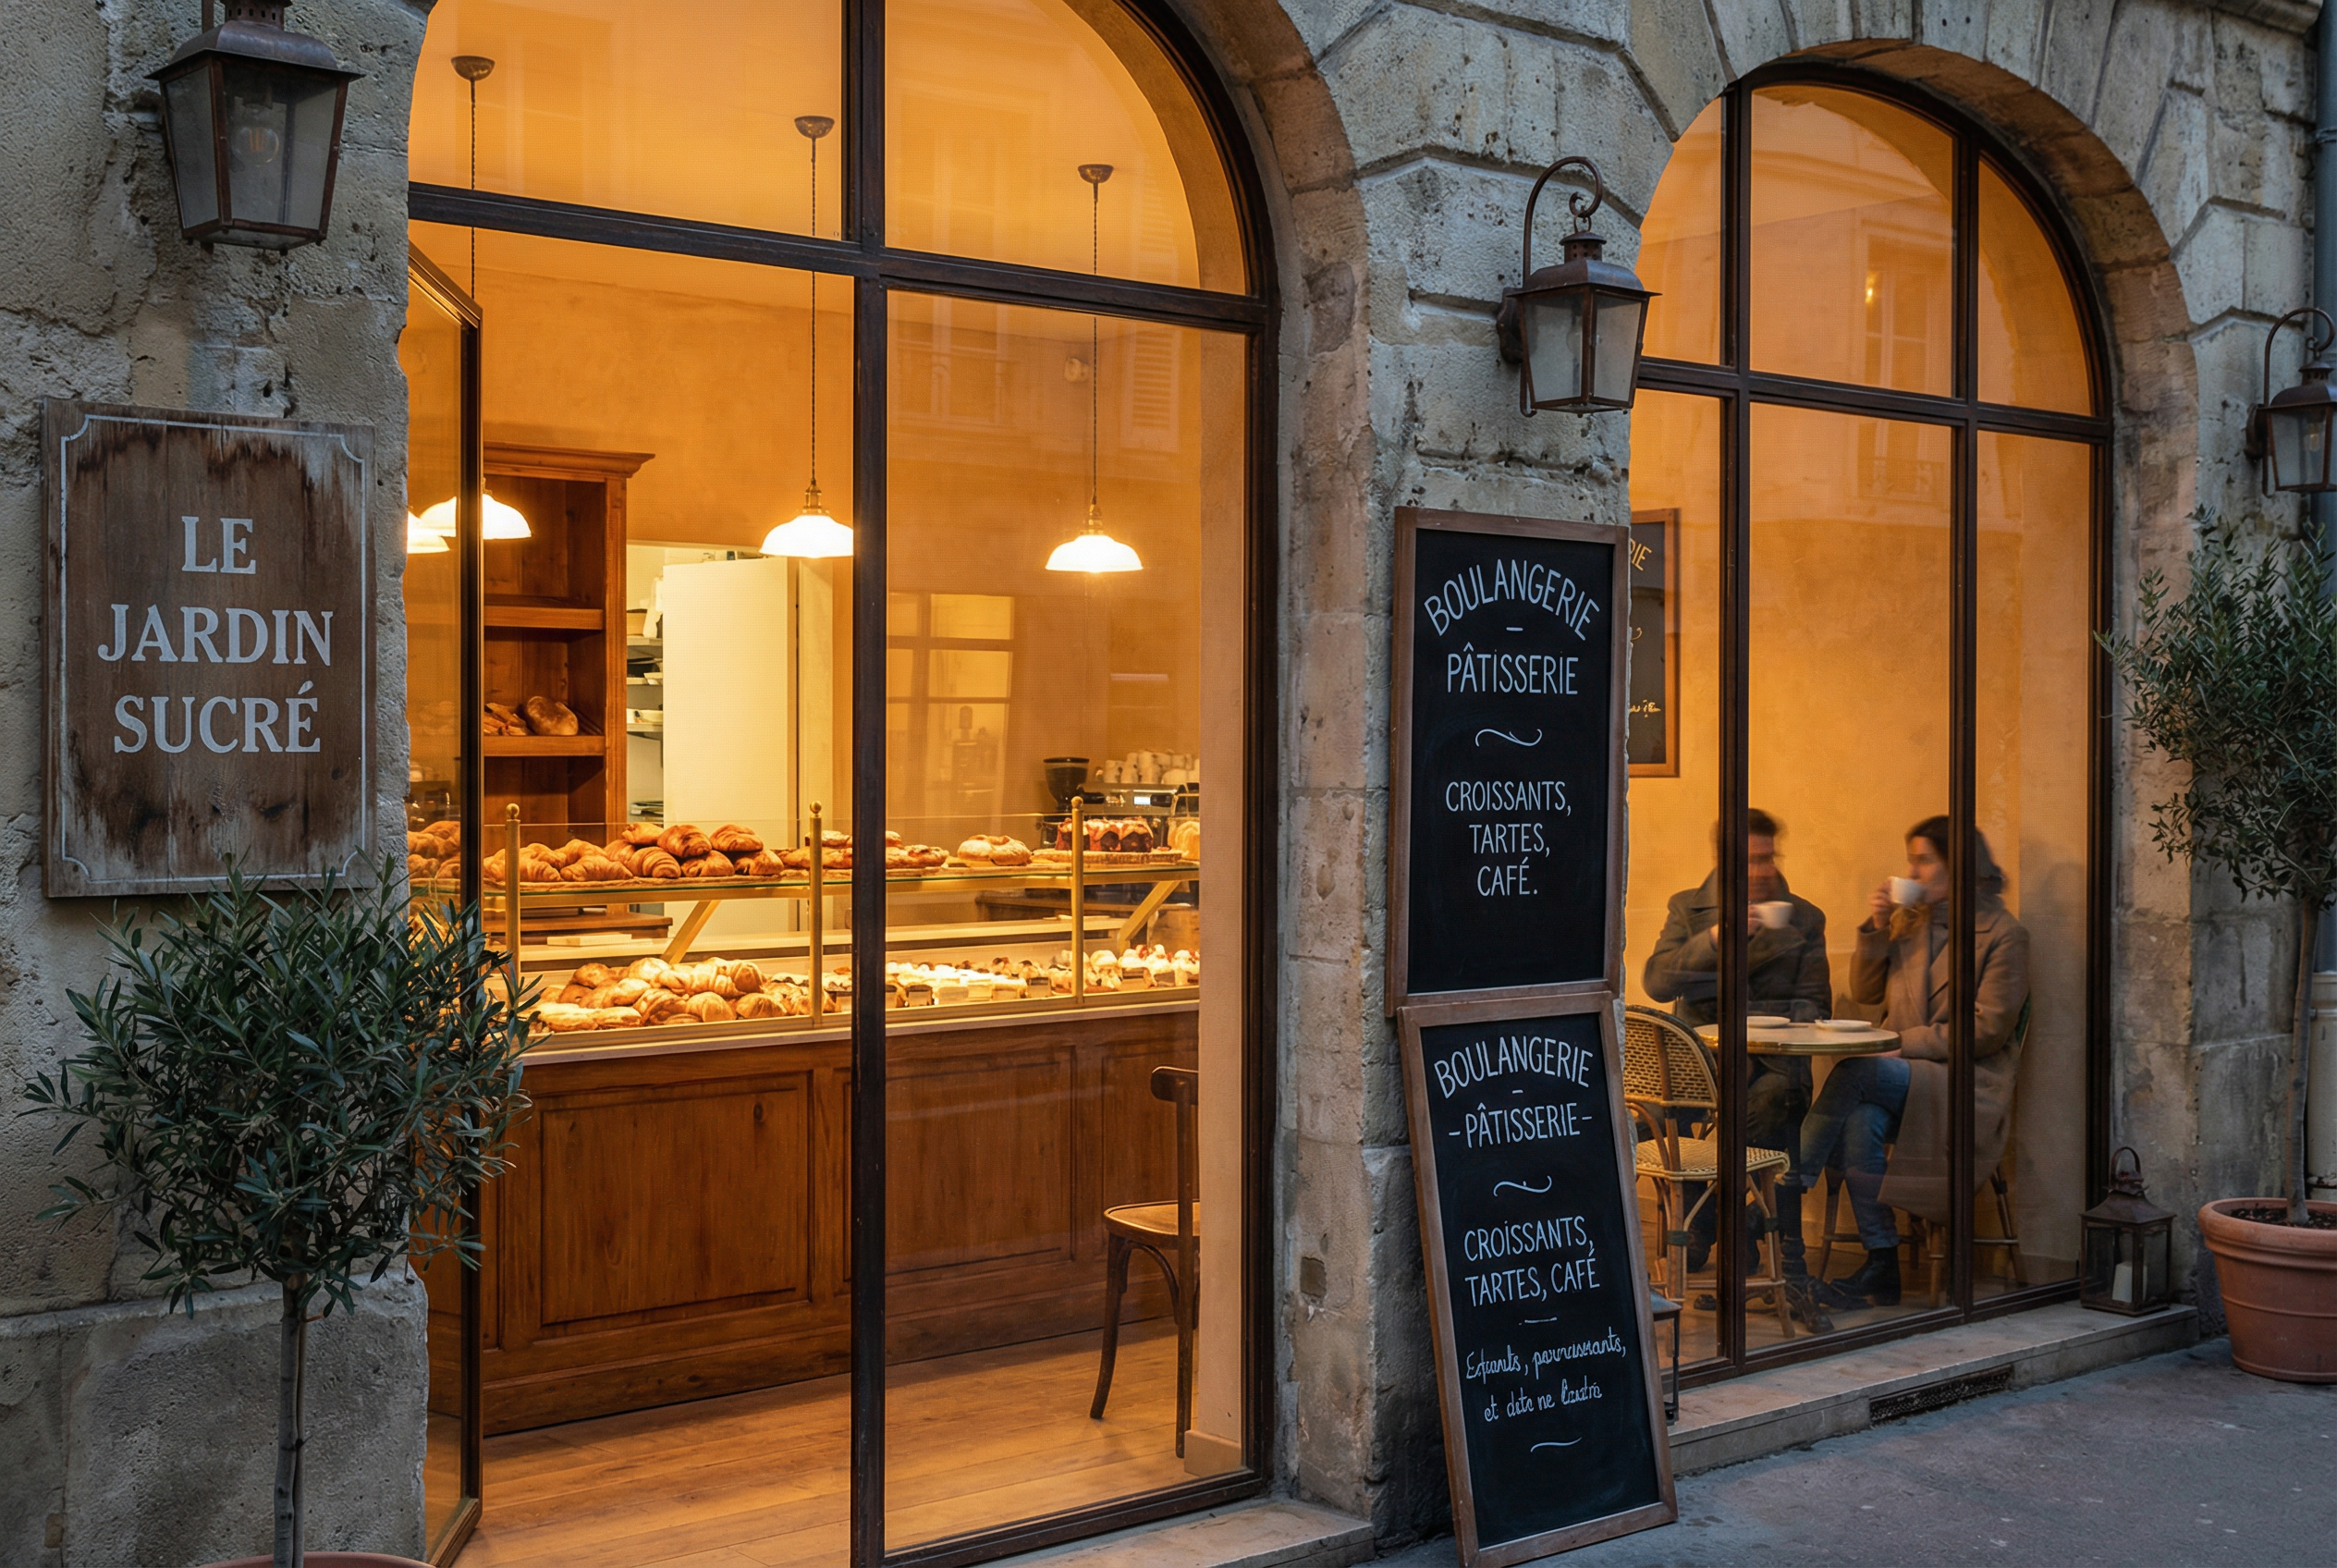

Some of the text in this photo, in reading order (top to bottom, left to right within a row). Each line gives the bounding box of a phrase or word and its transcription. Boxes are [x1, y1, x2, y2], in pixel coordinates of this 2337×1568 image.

[181, 515, 257, 574] LE
[1424, 558, 1600, 641] BOULANGERIE
[97, 604, 334, 666] JARDIN
[1447, 642, 1579, 695] PÂTISSERIE
[114, 680, 321, 753] SUCRÉ
[1445, 780, 1572, 816] CROISSANTS,
[1468, 822, 1550, 858] TARTES,
[1476, 856, 1538, 897] CAFÉ.
[1434, 1035, 1594, 1099] BOULANGERIE
[1463, 1215, 1596, 1262] CROISSANTS,
[1464, 1248, 1600, 1307] TARTES, CAFÉ
[1484, 1394, 1499, 1423] et
